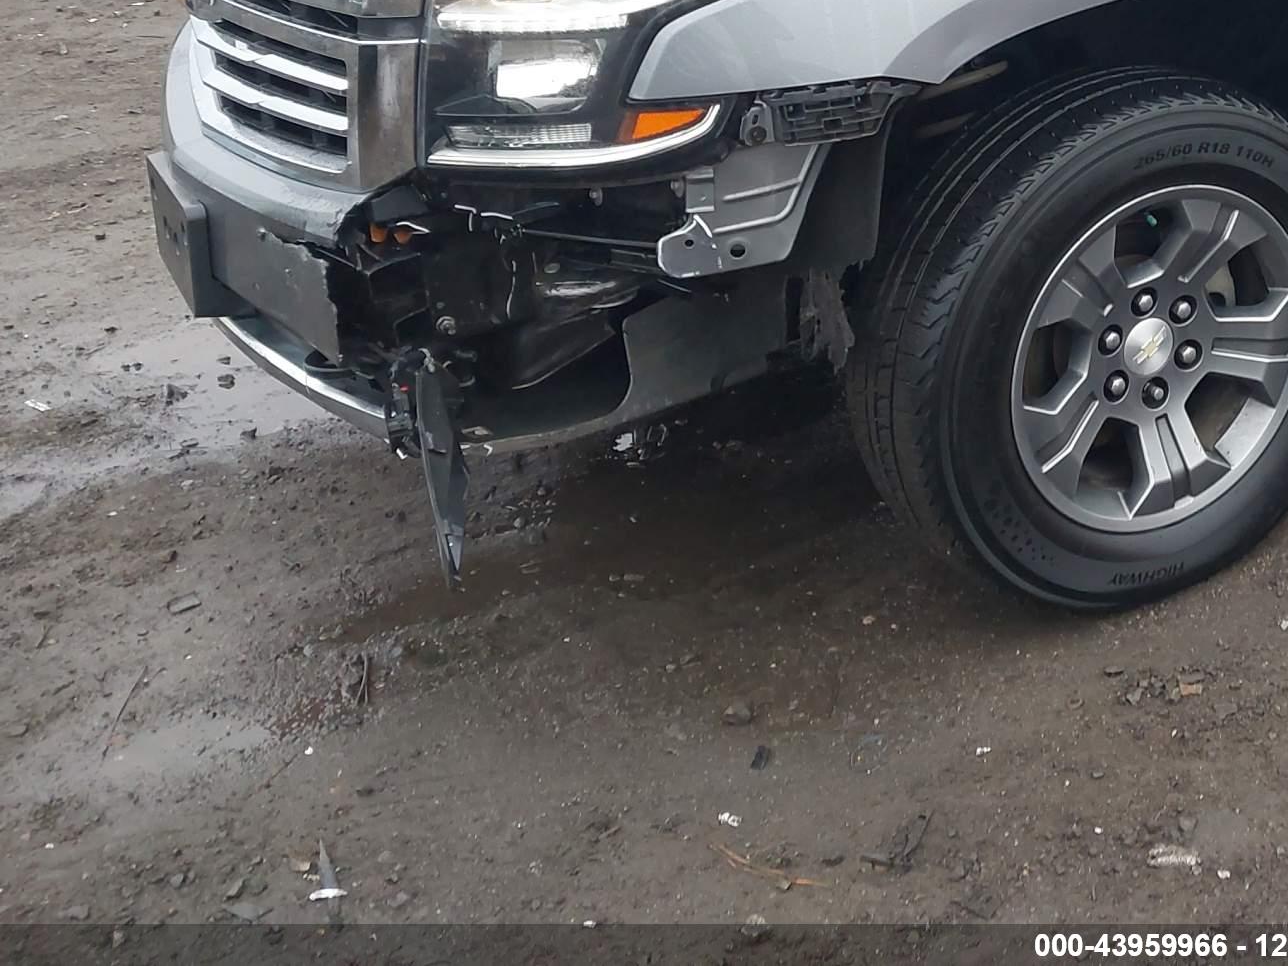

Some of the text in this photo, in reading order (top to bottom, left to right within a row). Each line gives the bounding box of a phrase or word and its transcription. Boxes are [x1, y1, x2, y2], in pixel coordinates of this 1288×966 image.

[1133, 141, 1275, 170] 265/60 R18 110H
[1107, 561, 1185, 587] HIGHWAY
